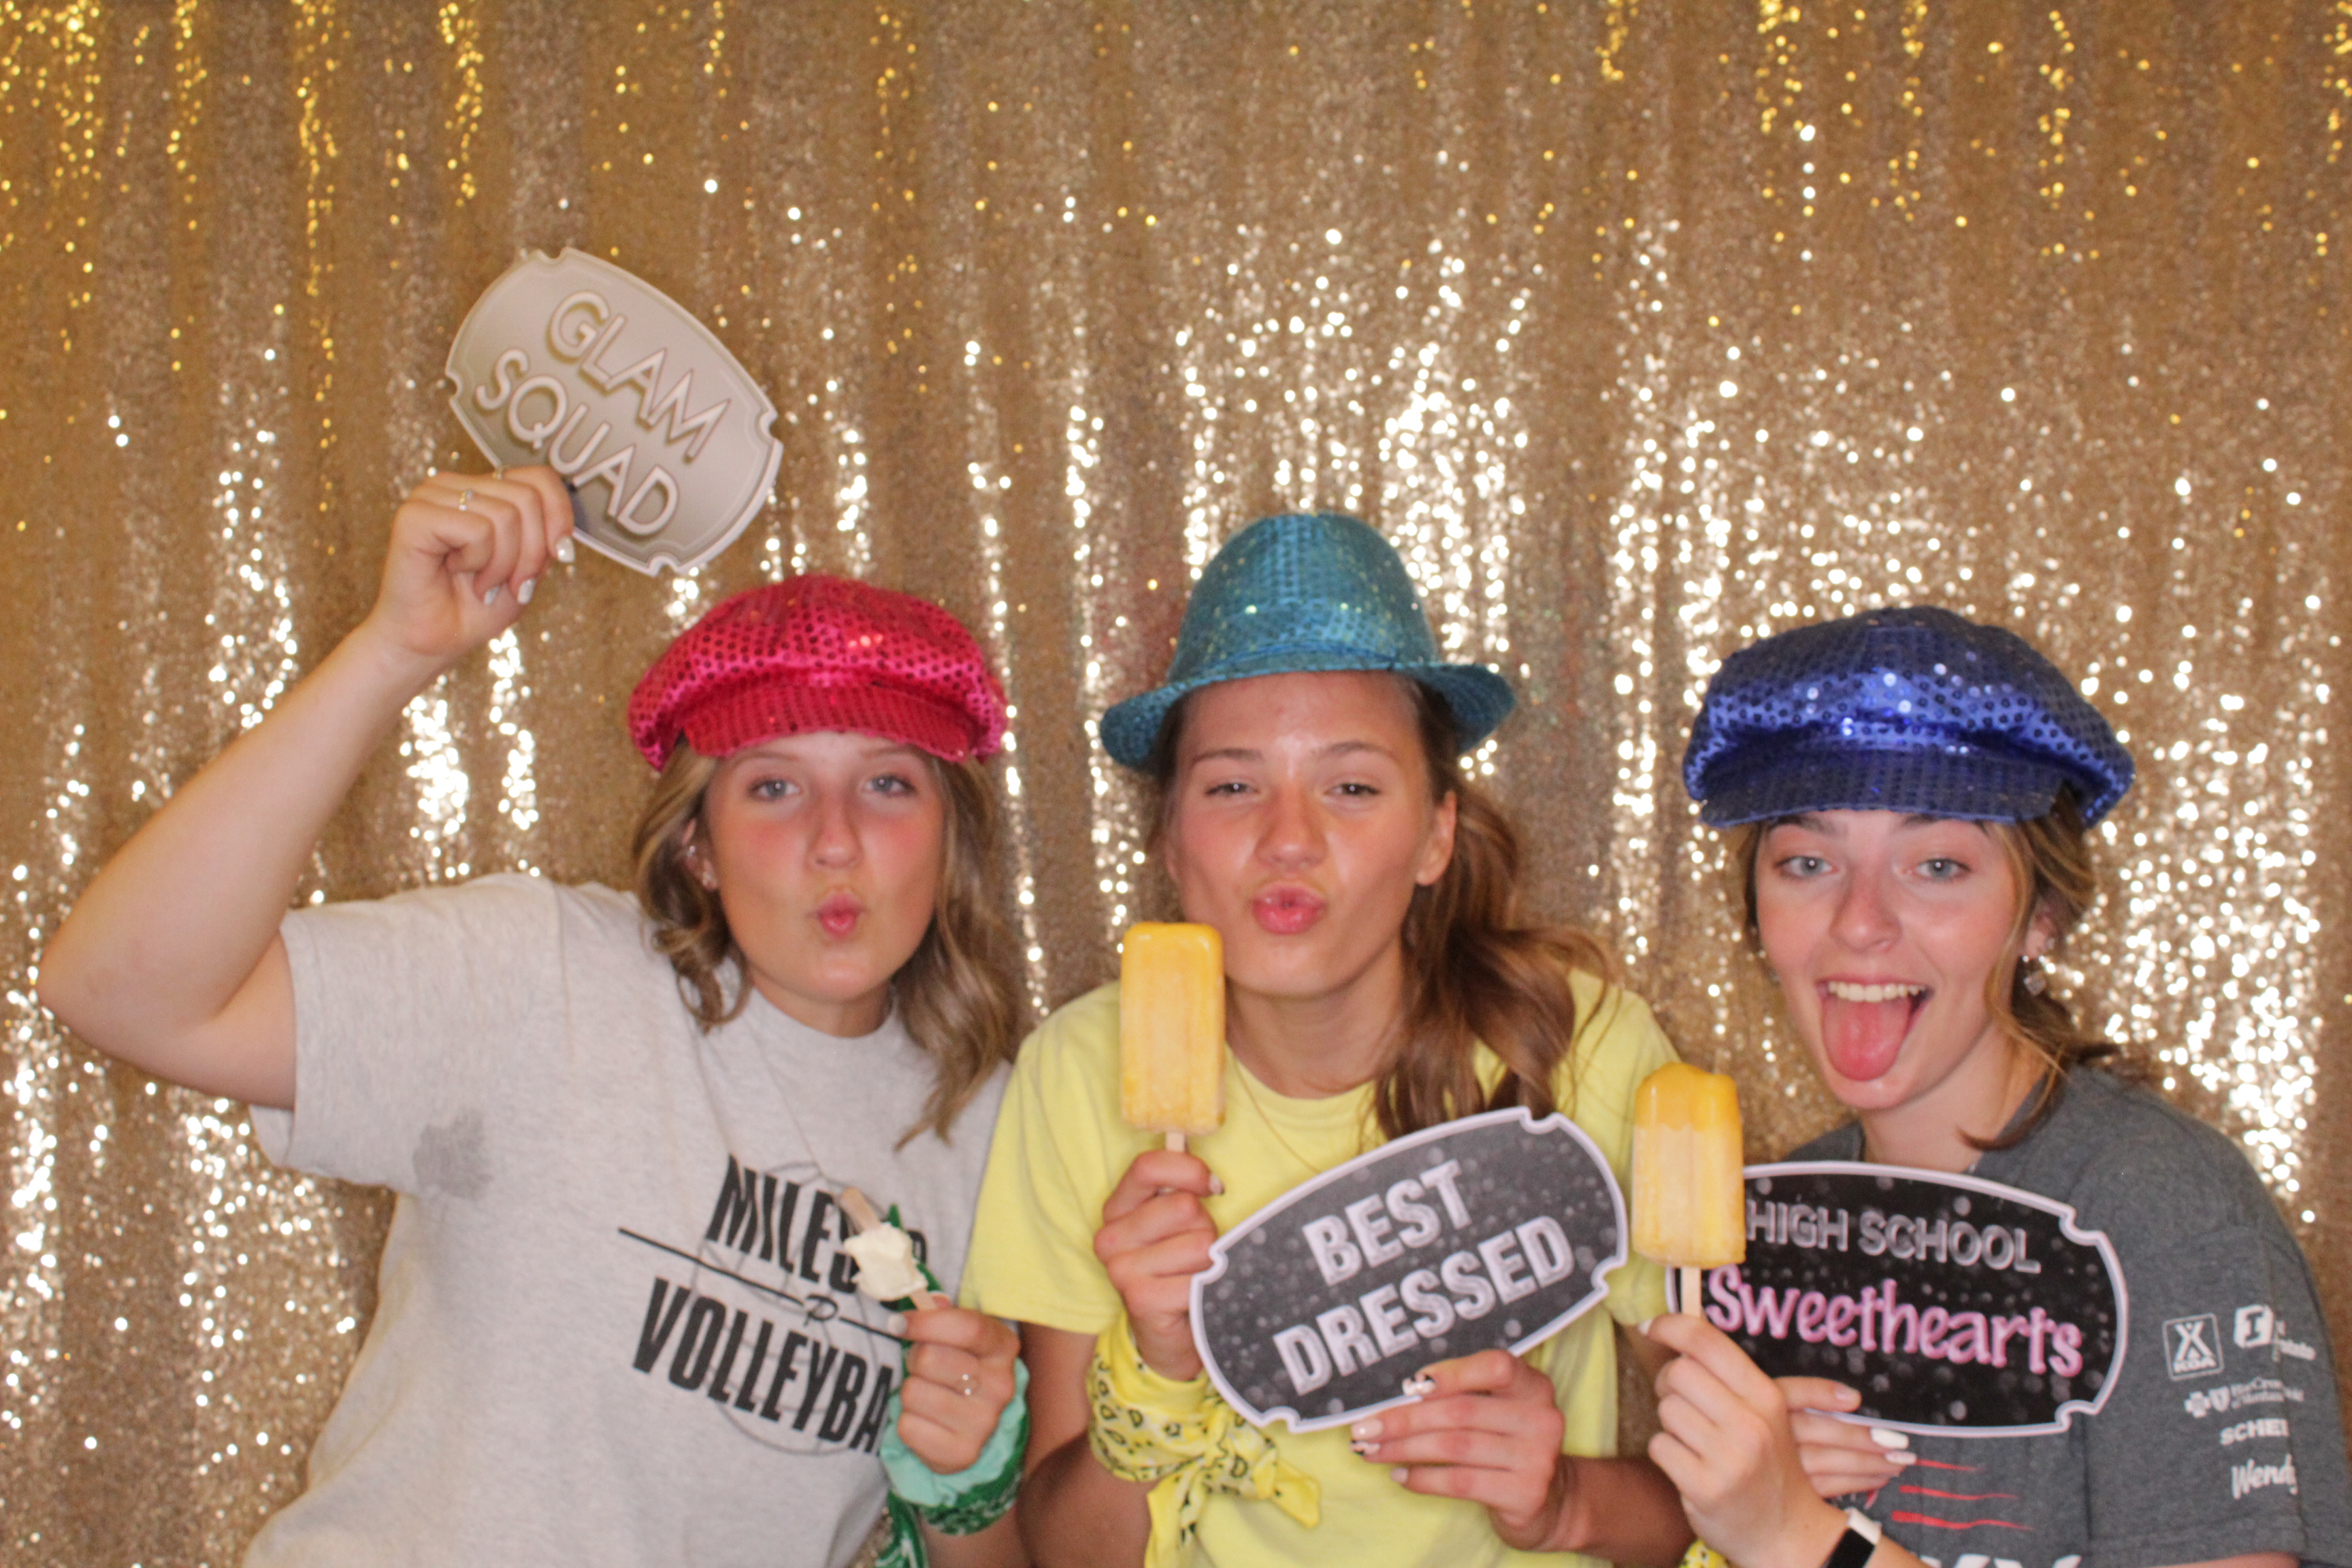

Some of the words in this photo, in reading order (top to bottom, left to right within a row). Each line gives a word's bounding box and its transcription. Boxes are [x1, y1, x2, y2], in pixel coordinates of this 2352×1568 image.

[477, 348, 679, 536] SQUAD
[549, 291, 732, 461] GLAM
[1273, 1215, 1575, 1396] DRESSED
[1301, 1158, 1472, 1287] BEST
[1746, 1198, 1849, 1252] HIGH
[1858, 1209, 2041, 1274] SCHOOL
[632, 1276, 894, 1457] VOLLEYBA
[1705, 1263, 2084, 1378] Sweethearts
